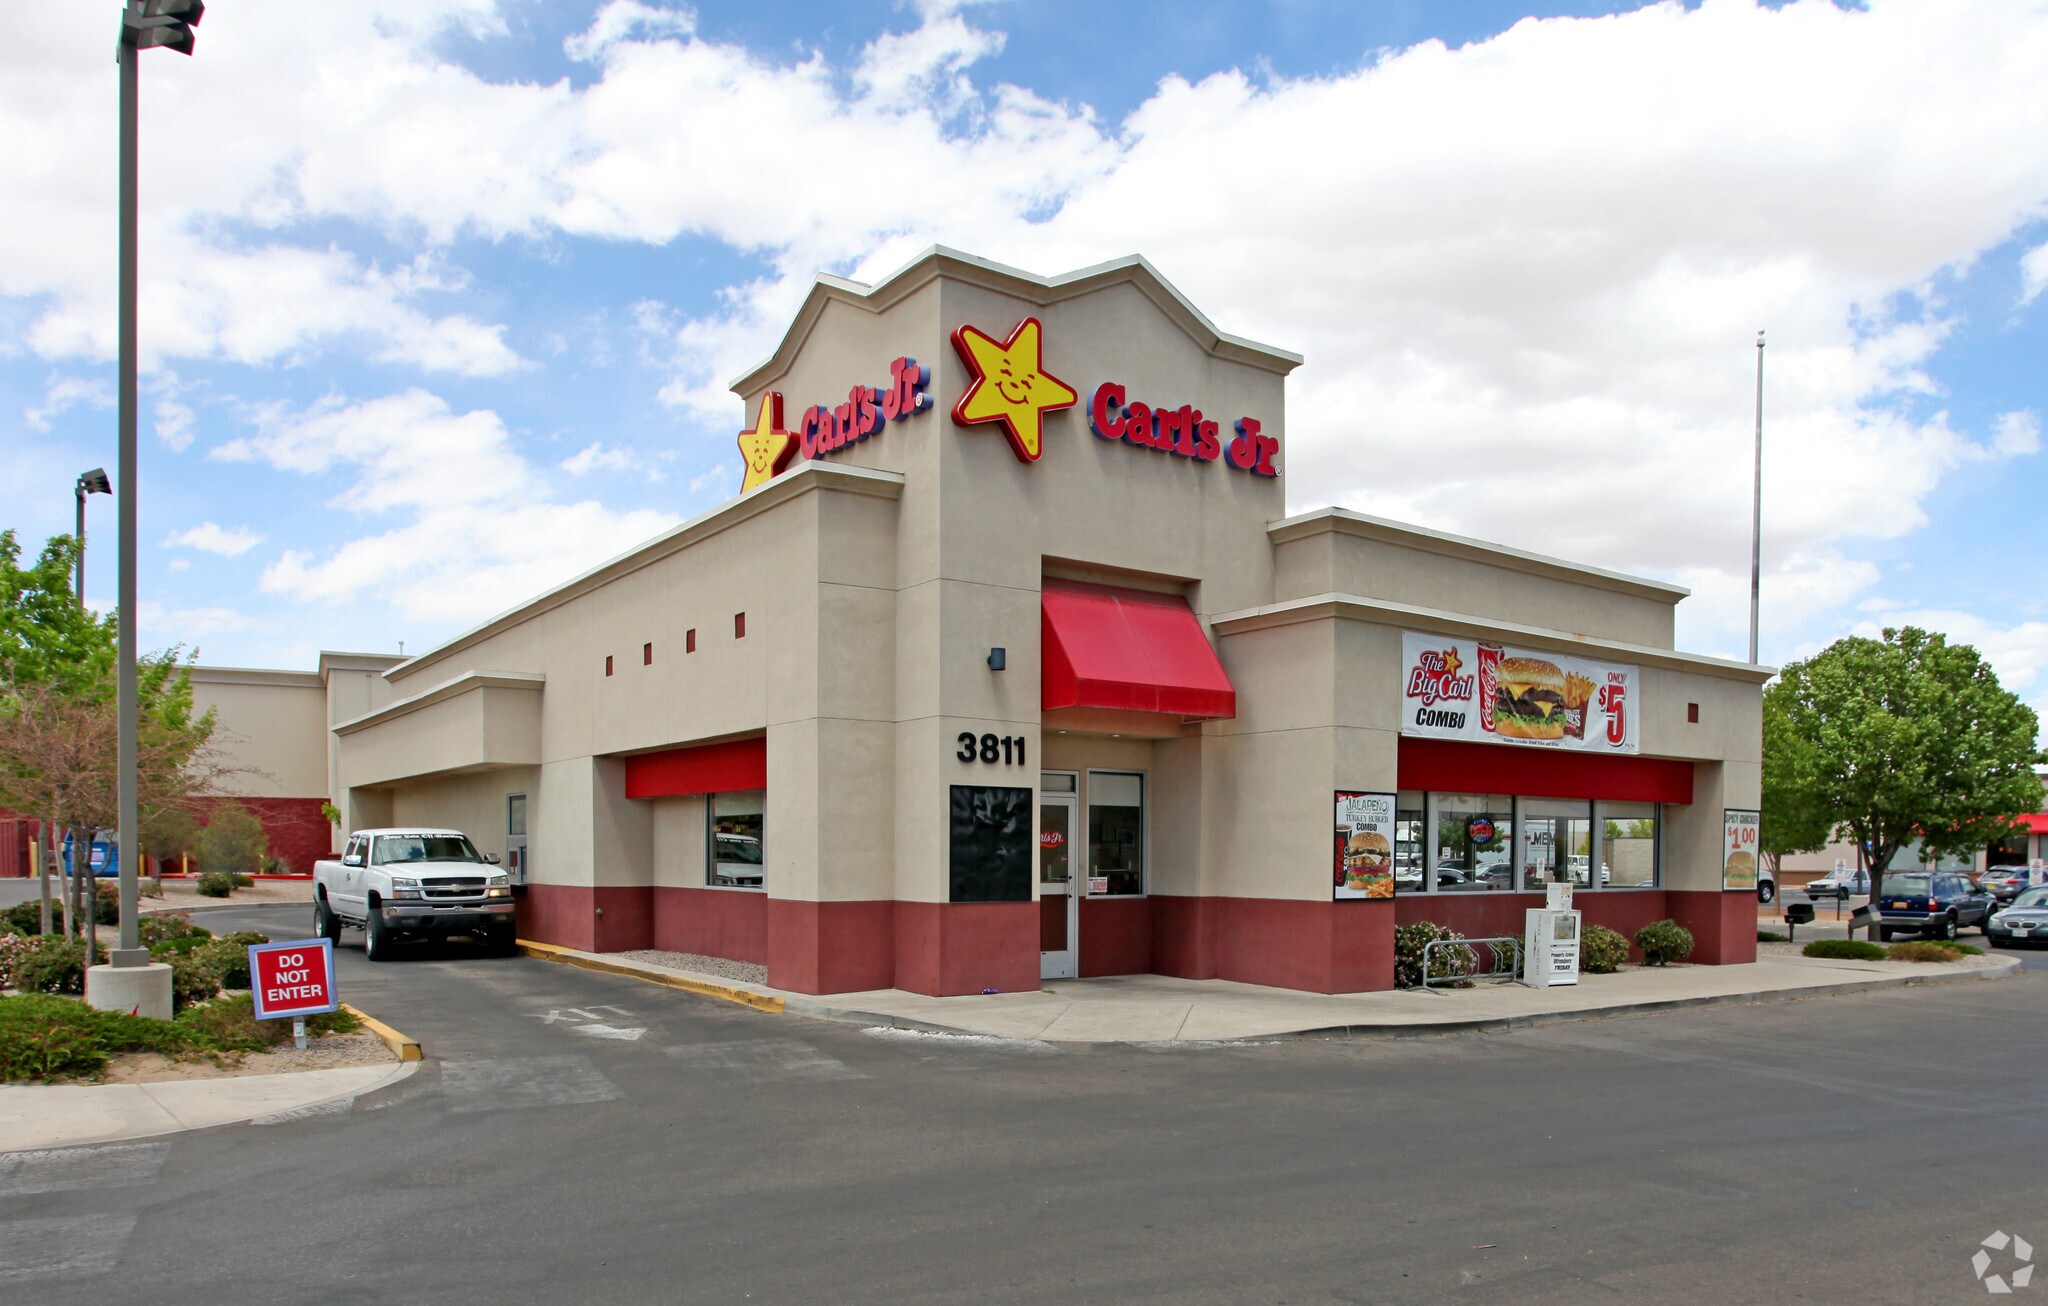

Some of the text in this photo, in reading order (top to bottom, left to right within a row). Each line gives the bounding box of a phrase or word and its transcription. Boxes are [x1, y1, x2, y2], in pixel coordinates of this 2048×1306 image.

[800, 384, 880, 460] Carl's
[1088, 382, 1220, 463] Carl's
[1421, 653, 1444, 672] The
[1409, 669, 1473, 703] Big Carl
[1415, 707, 1466, 729] COMBO
[957, 732, 1025, 766] 3811
[1346, 814, 1389, 823] TURKEY BURGER
[1356, 822, 1378, 832] COMBO
[1469, 824, 1493, 838] OPEN
[278, 953, 304, 968] DO
[276, 969, 310, 984] NOT
[267, 984, 322, 1002] ENTER
